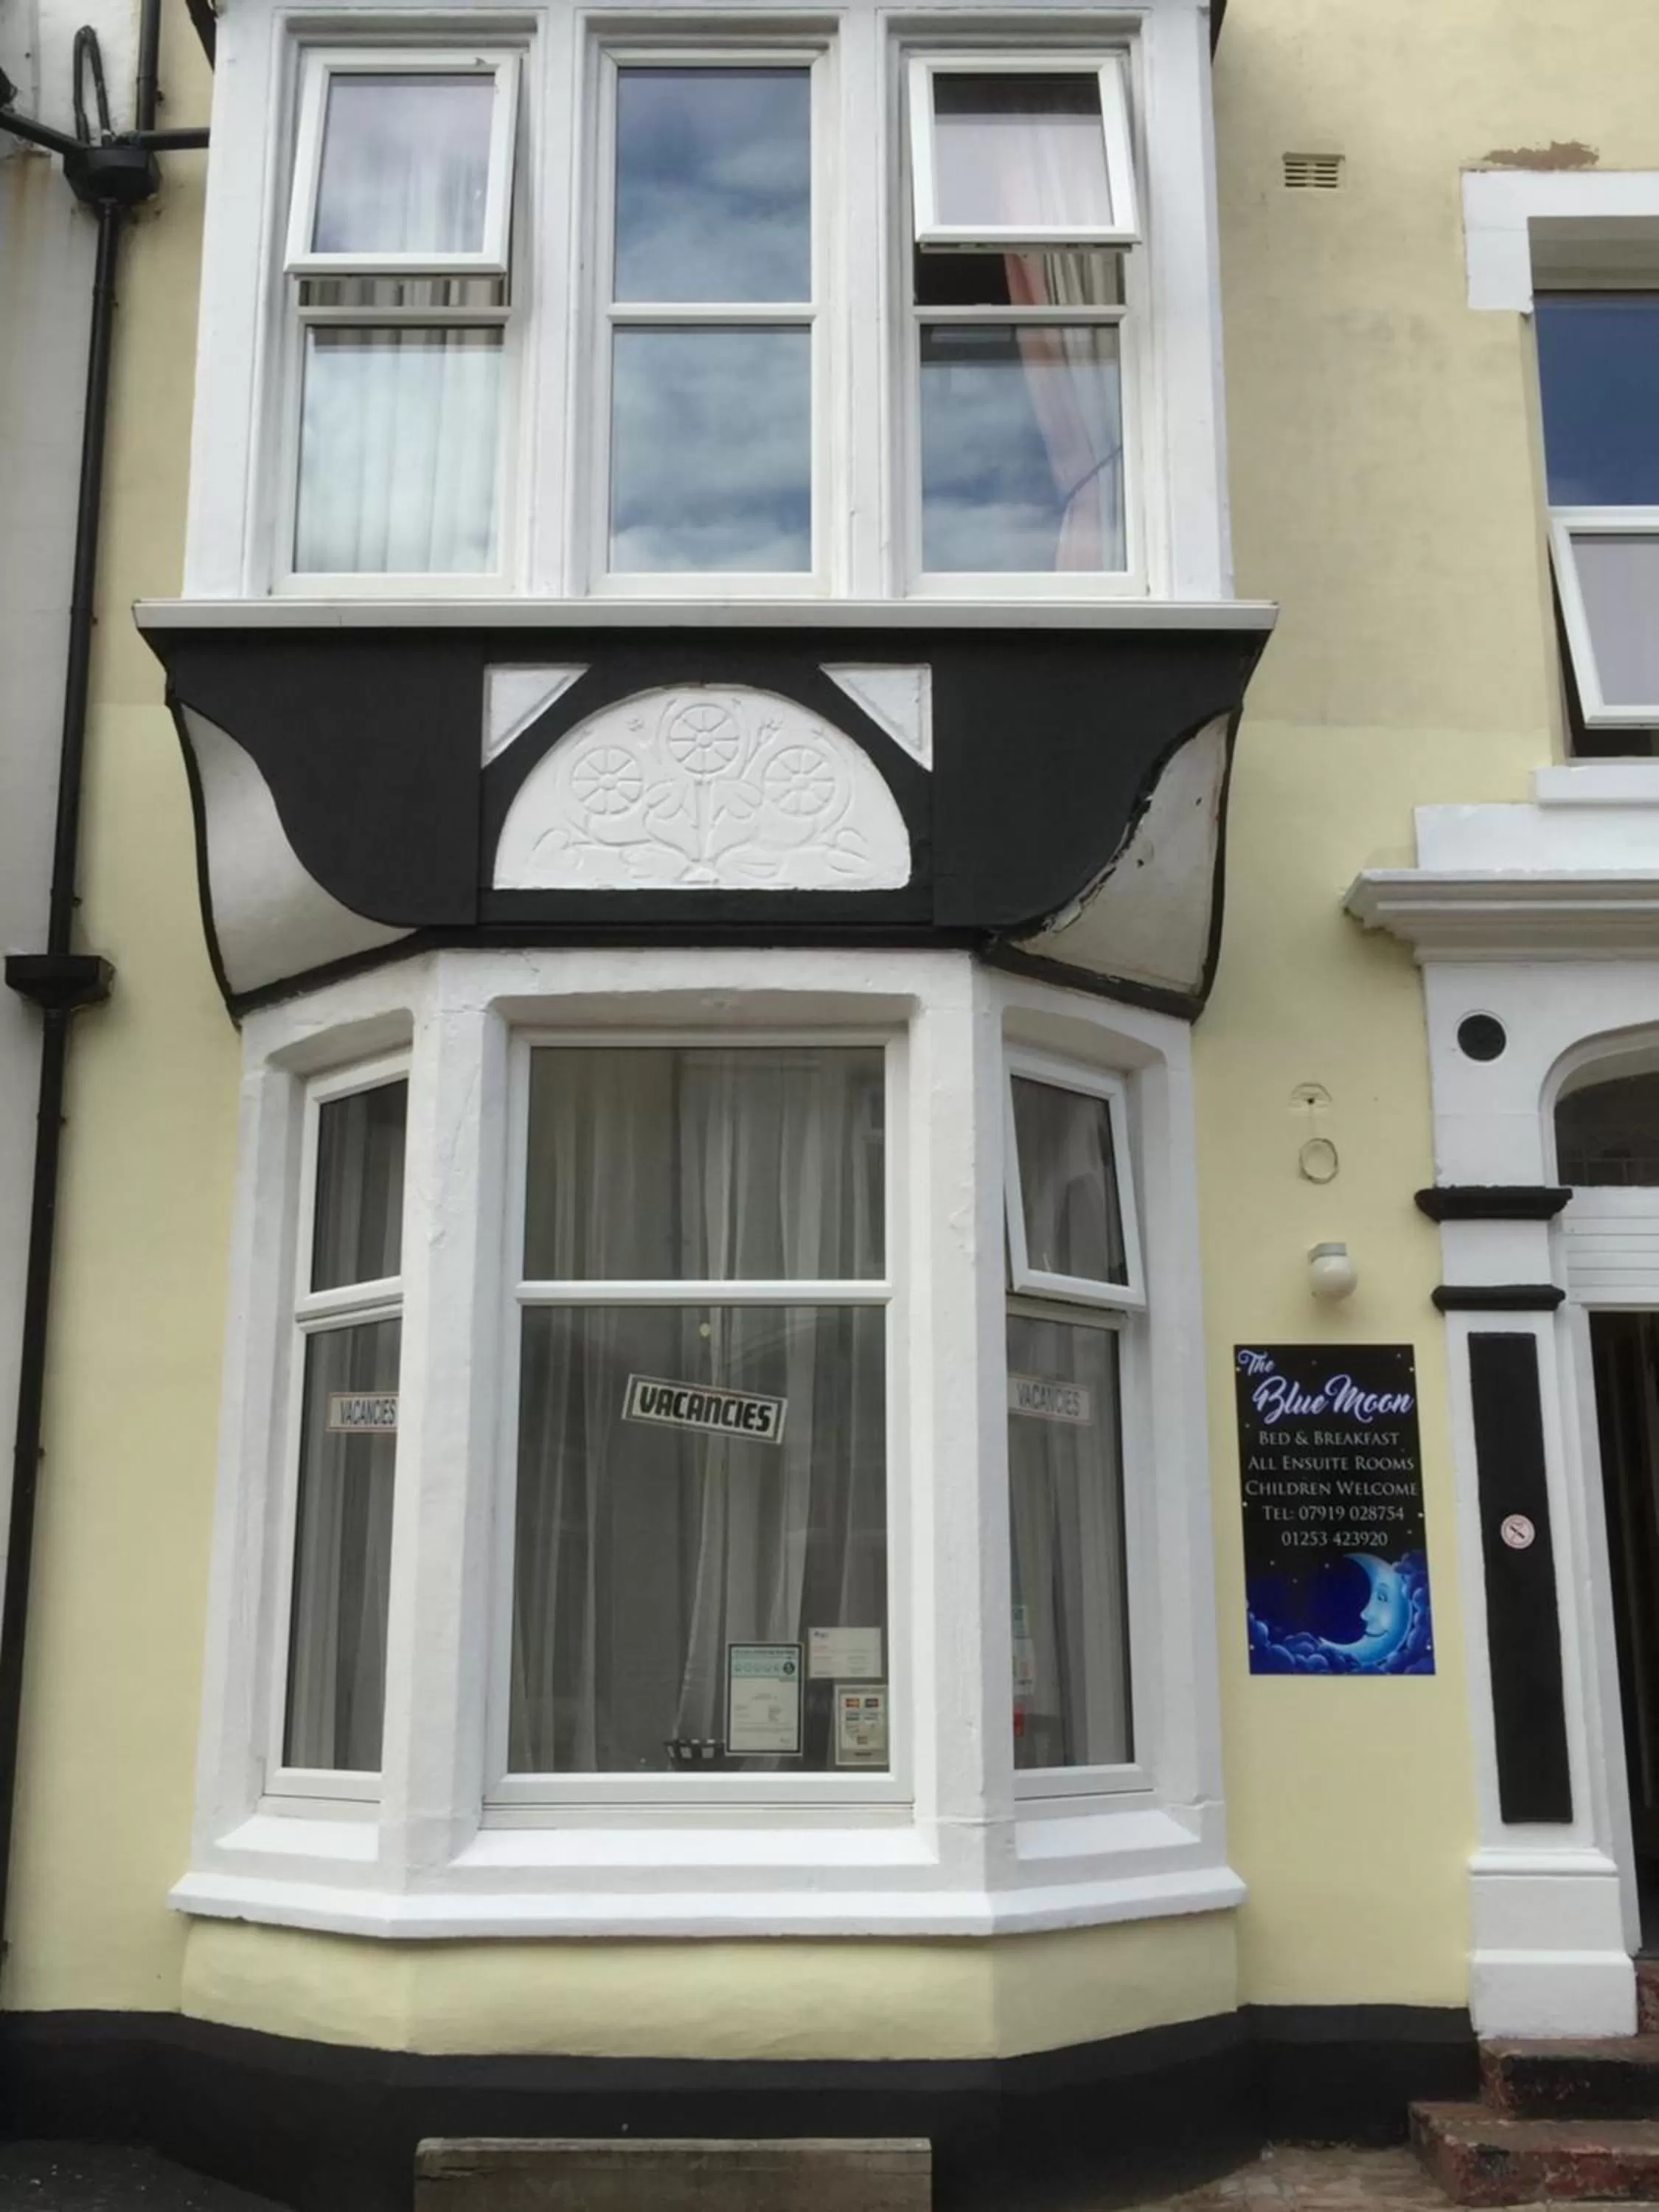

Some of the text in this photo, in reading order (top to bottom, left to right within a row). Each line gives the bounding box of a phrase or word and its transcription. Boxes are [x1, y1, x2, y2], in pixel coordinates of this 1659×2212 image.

[1238, 1349, 1274, 1376] The
[639, 1385, 772, 1432] VACANCIES
[1017, 1382, 1079, 1416] VACANCIES
[1252, 1374, 1413, 1424] Blue Moon
[341, 1399, 396, 1425] VACANCIES
[1259, 1431, 1399, 1446] BED & BREAKFAST
[1248, 1455, 1414, 1471] ALL ENSUITE ROOMS
[1245, 1480, 1417, 1496] CHILDREN WELCOME
[1262, 1505, 1404, 1521] TEL: 07919 028754
[1281, 1531, 1388, 1546] 01253 423920
